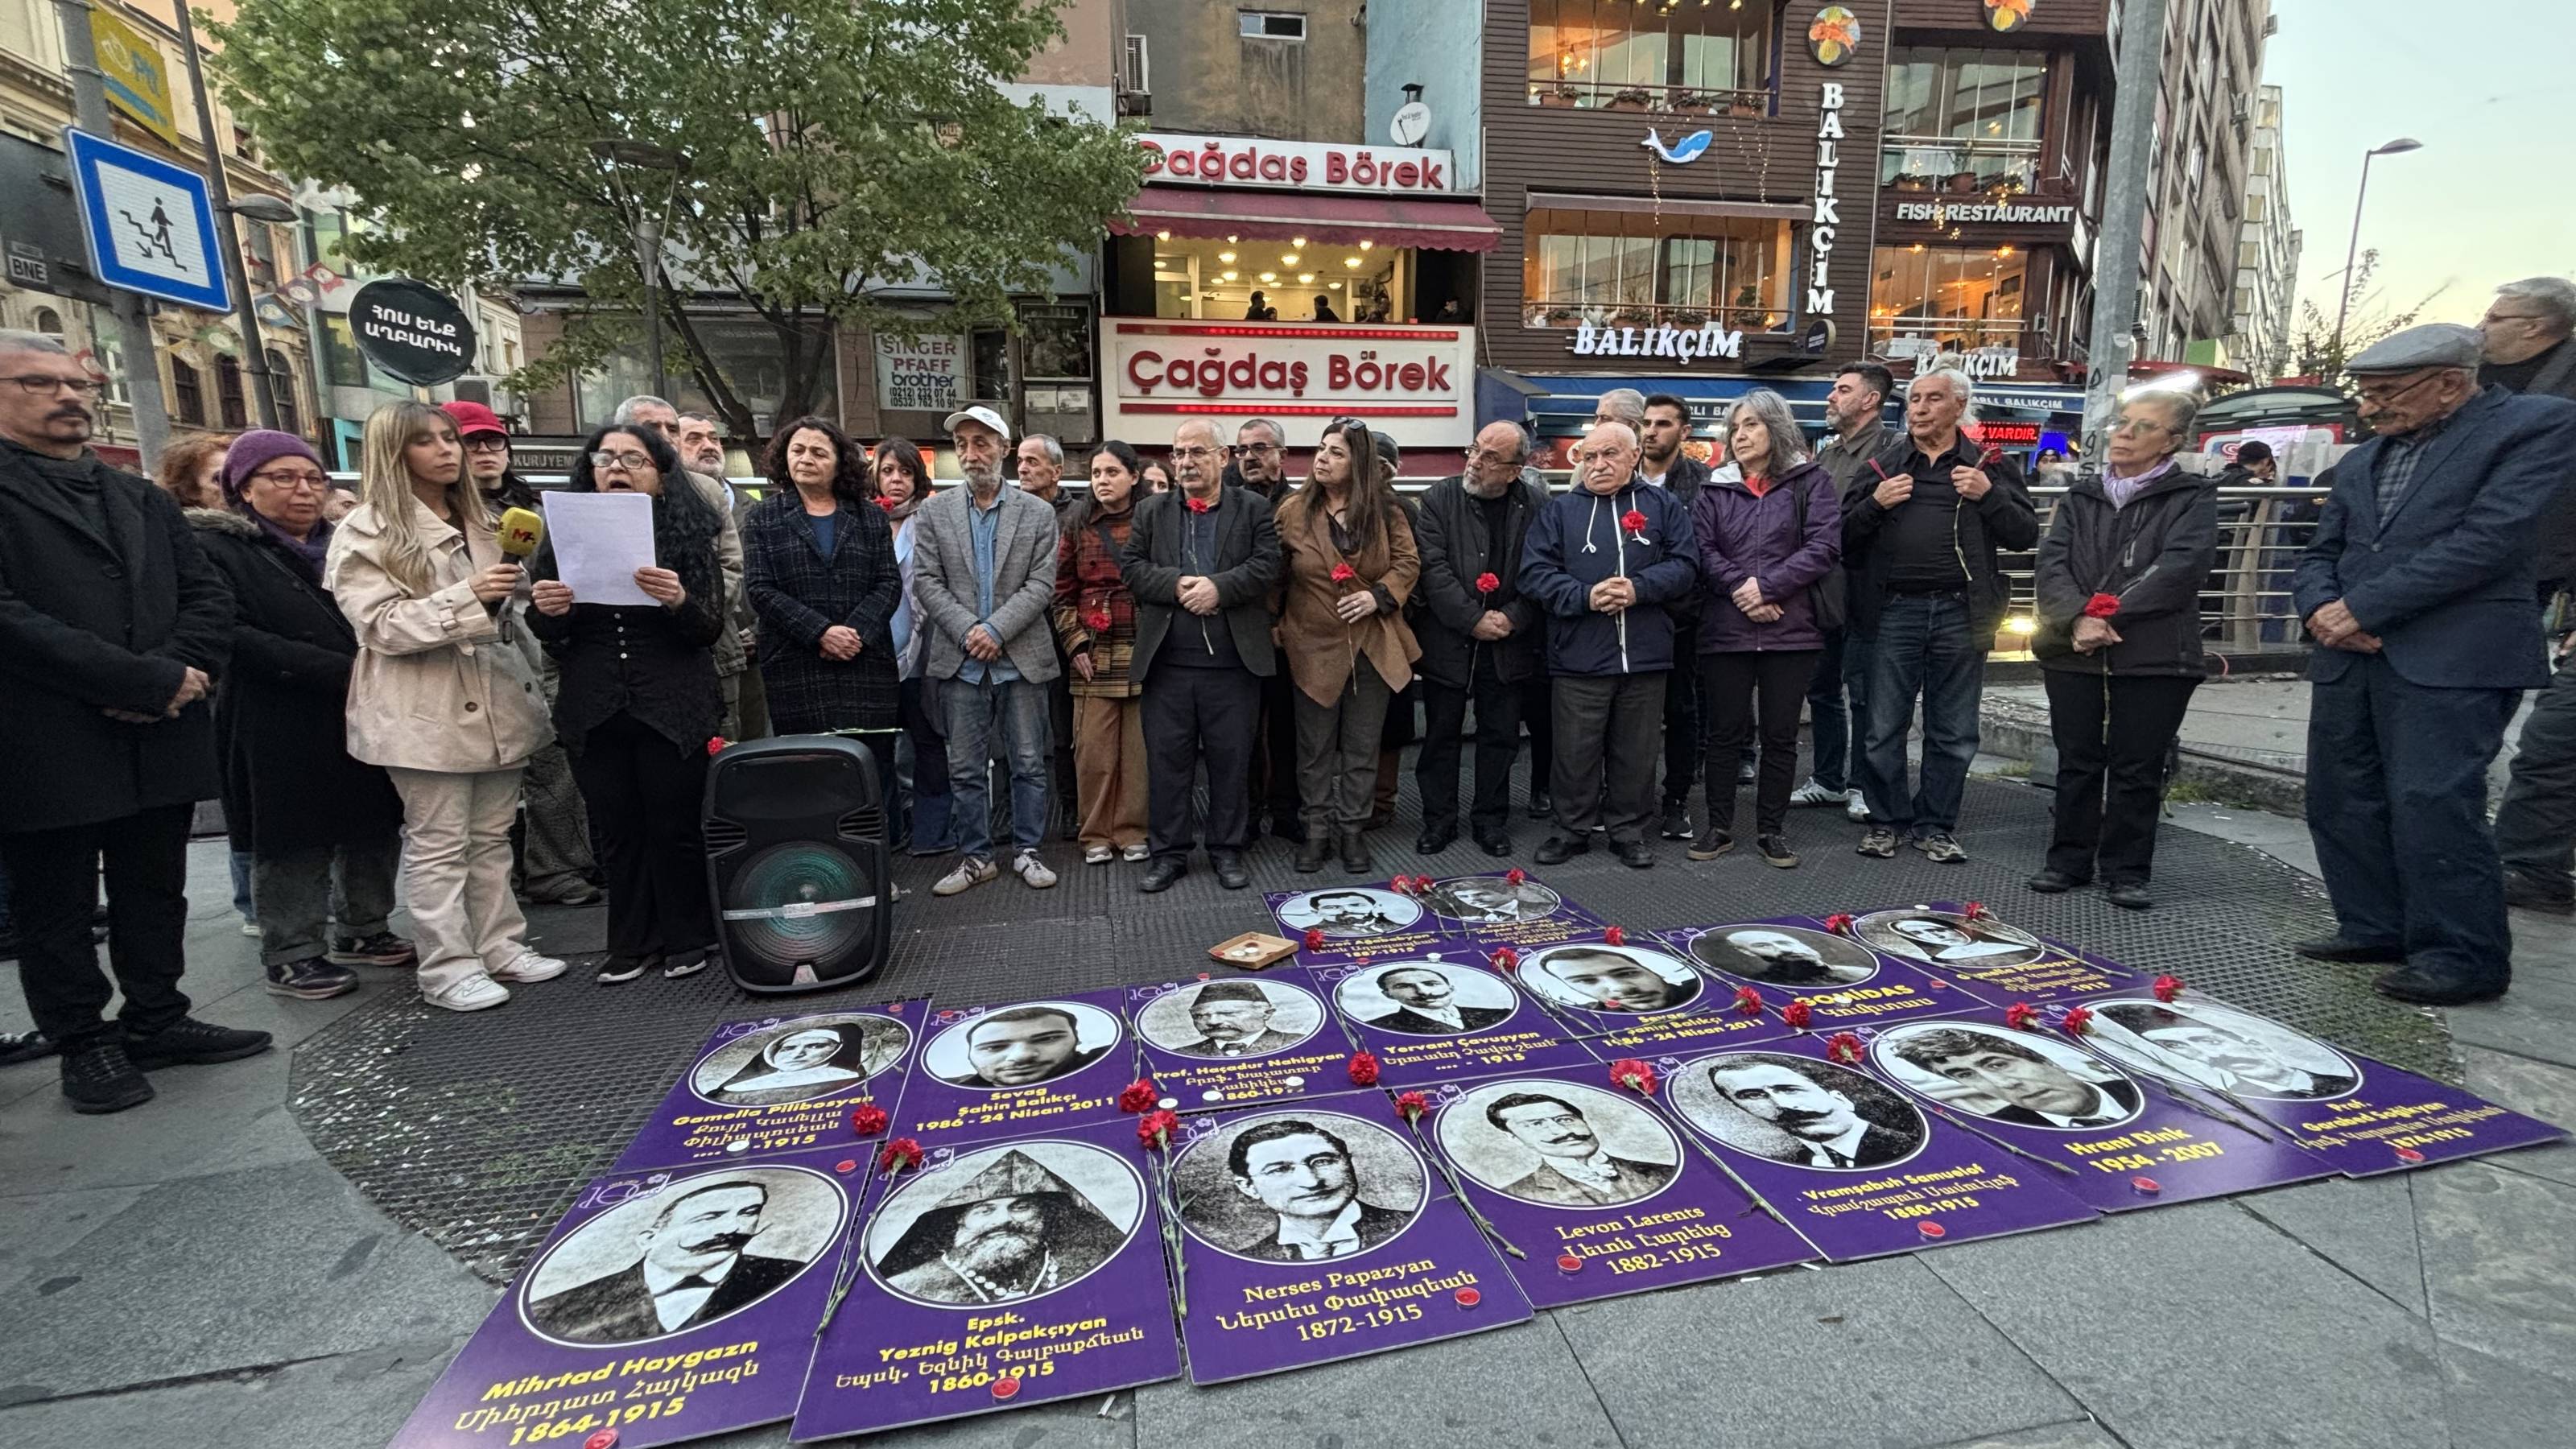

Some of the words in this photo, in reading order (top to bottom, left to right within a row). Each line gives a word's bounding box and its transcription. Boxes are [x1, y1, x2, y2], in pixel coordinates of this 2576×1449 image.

[1327, 151, 1443, 188] Börek
[1806, 83, 1844, 314] BALIKÇIM
[1897, 203, 1941, 221] FISH
[1945, 204, 2074, 223] RESTAURANT
[883, 341, 956, 355] SINGER
[1573, 326, 1743, 365] BALIKÇIM
[891, 372, 956, 387] brother
[893, 358, 952, 372] PFAFF
[1129, 348, 1308, 396] Çağdaş
[1328, 350, 1451, 390] Börek
[890, 387, 914, 397] (0212)
[918, 388, 931, 398] 232
[934, 388, 943, 398] 07
[947, 389, 956, 398] 44
[919, 398, 932, 407] 762
[936, 398, 945, 407] 10
[1385, 1041, 1454, 1055] Yervant
[1457, 1031, 1541, 1047] Çavuşyan
[1653, 1031, 1677, 1042] 24
[1677, 1025, 1725, 1038] Nisan
[1725, 1018, 1765, 1031] 2011
[1196, 1062, 1265, 1076] Haçadur
[1268, 1053, 1346, 1067] Nahigyan
[1480, 1053, 1525, 1064] 1915
[958, 1101, 1009, 1117] Şahin
[1017, 1093, 1076, 1108] Balıkçı
[990, 1088, 1047, 1101] Sevag
[673, 1108, 761, 1126] Gamella
[916, 1118, 964, 1132] 1986
[980, 1113, 1004, 1124] 24
[1009, 1105, 1064, 1120] Nisan
[1069, 1097, 1114, 1111] 2011
[2064, 1136, 2137, 1156] Hrant
[2130, 1127, 2194, 1145] Dink
[2384, 1127, 2475, 1149] 1874-1915
[2089, 1154, 2157, 1173] 1954
[2161, 1141, 2224, 1162] 2007
[1802, 1177, 1906, 1200] Vramşabuh
[1904, 1163, 1986, 1185] Samuelof
[1882, 1196, 1979, 1220] 1880-1915
[1554, 1220, 1625, 1240] Levon
[1624, 1208, 1705, 1228] Larents
[1606, 1243, 1721, 1274] 1882-1915
[1243, 1278, 1322, 1303] Nerses
[1327, 1259, 1436, 1288] Papazyan
[968, 1312, 1026, 1331] Epsk.
[1216, 1302, 1319, 1331] Ներսես
[1297, 1302, 1422, 1342] 1872-1915
[879, 1340, 960, 1362] Yeznig
[965, 1316, 1107, 1350] Kalpakçıyan
[481, 1361, 617, 1402] Mihrtad
[618, 1340, 758, 1377] Haygazn
[624, 1360, 760, 1400] Հայկազն
[929, 1360, 1055, 1394] 1860-1915
[509, 1396, 687, 1447] 1864-1915
